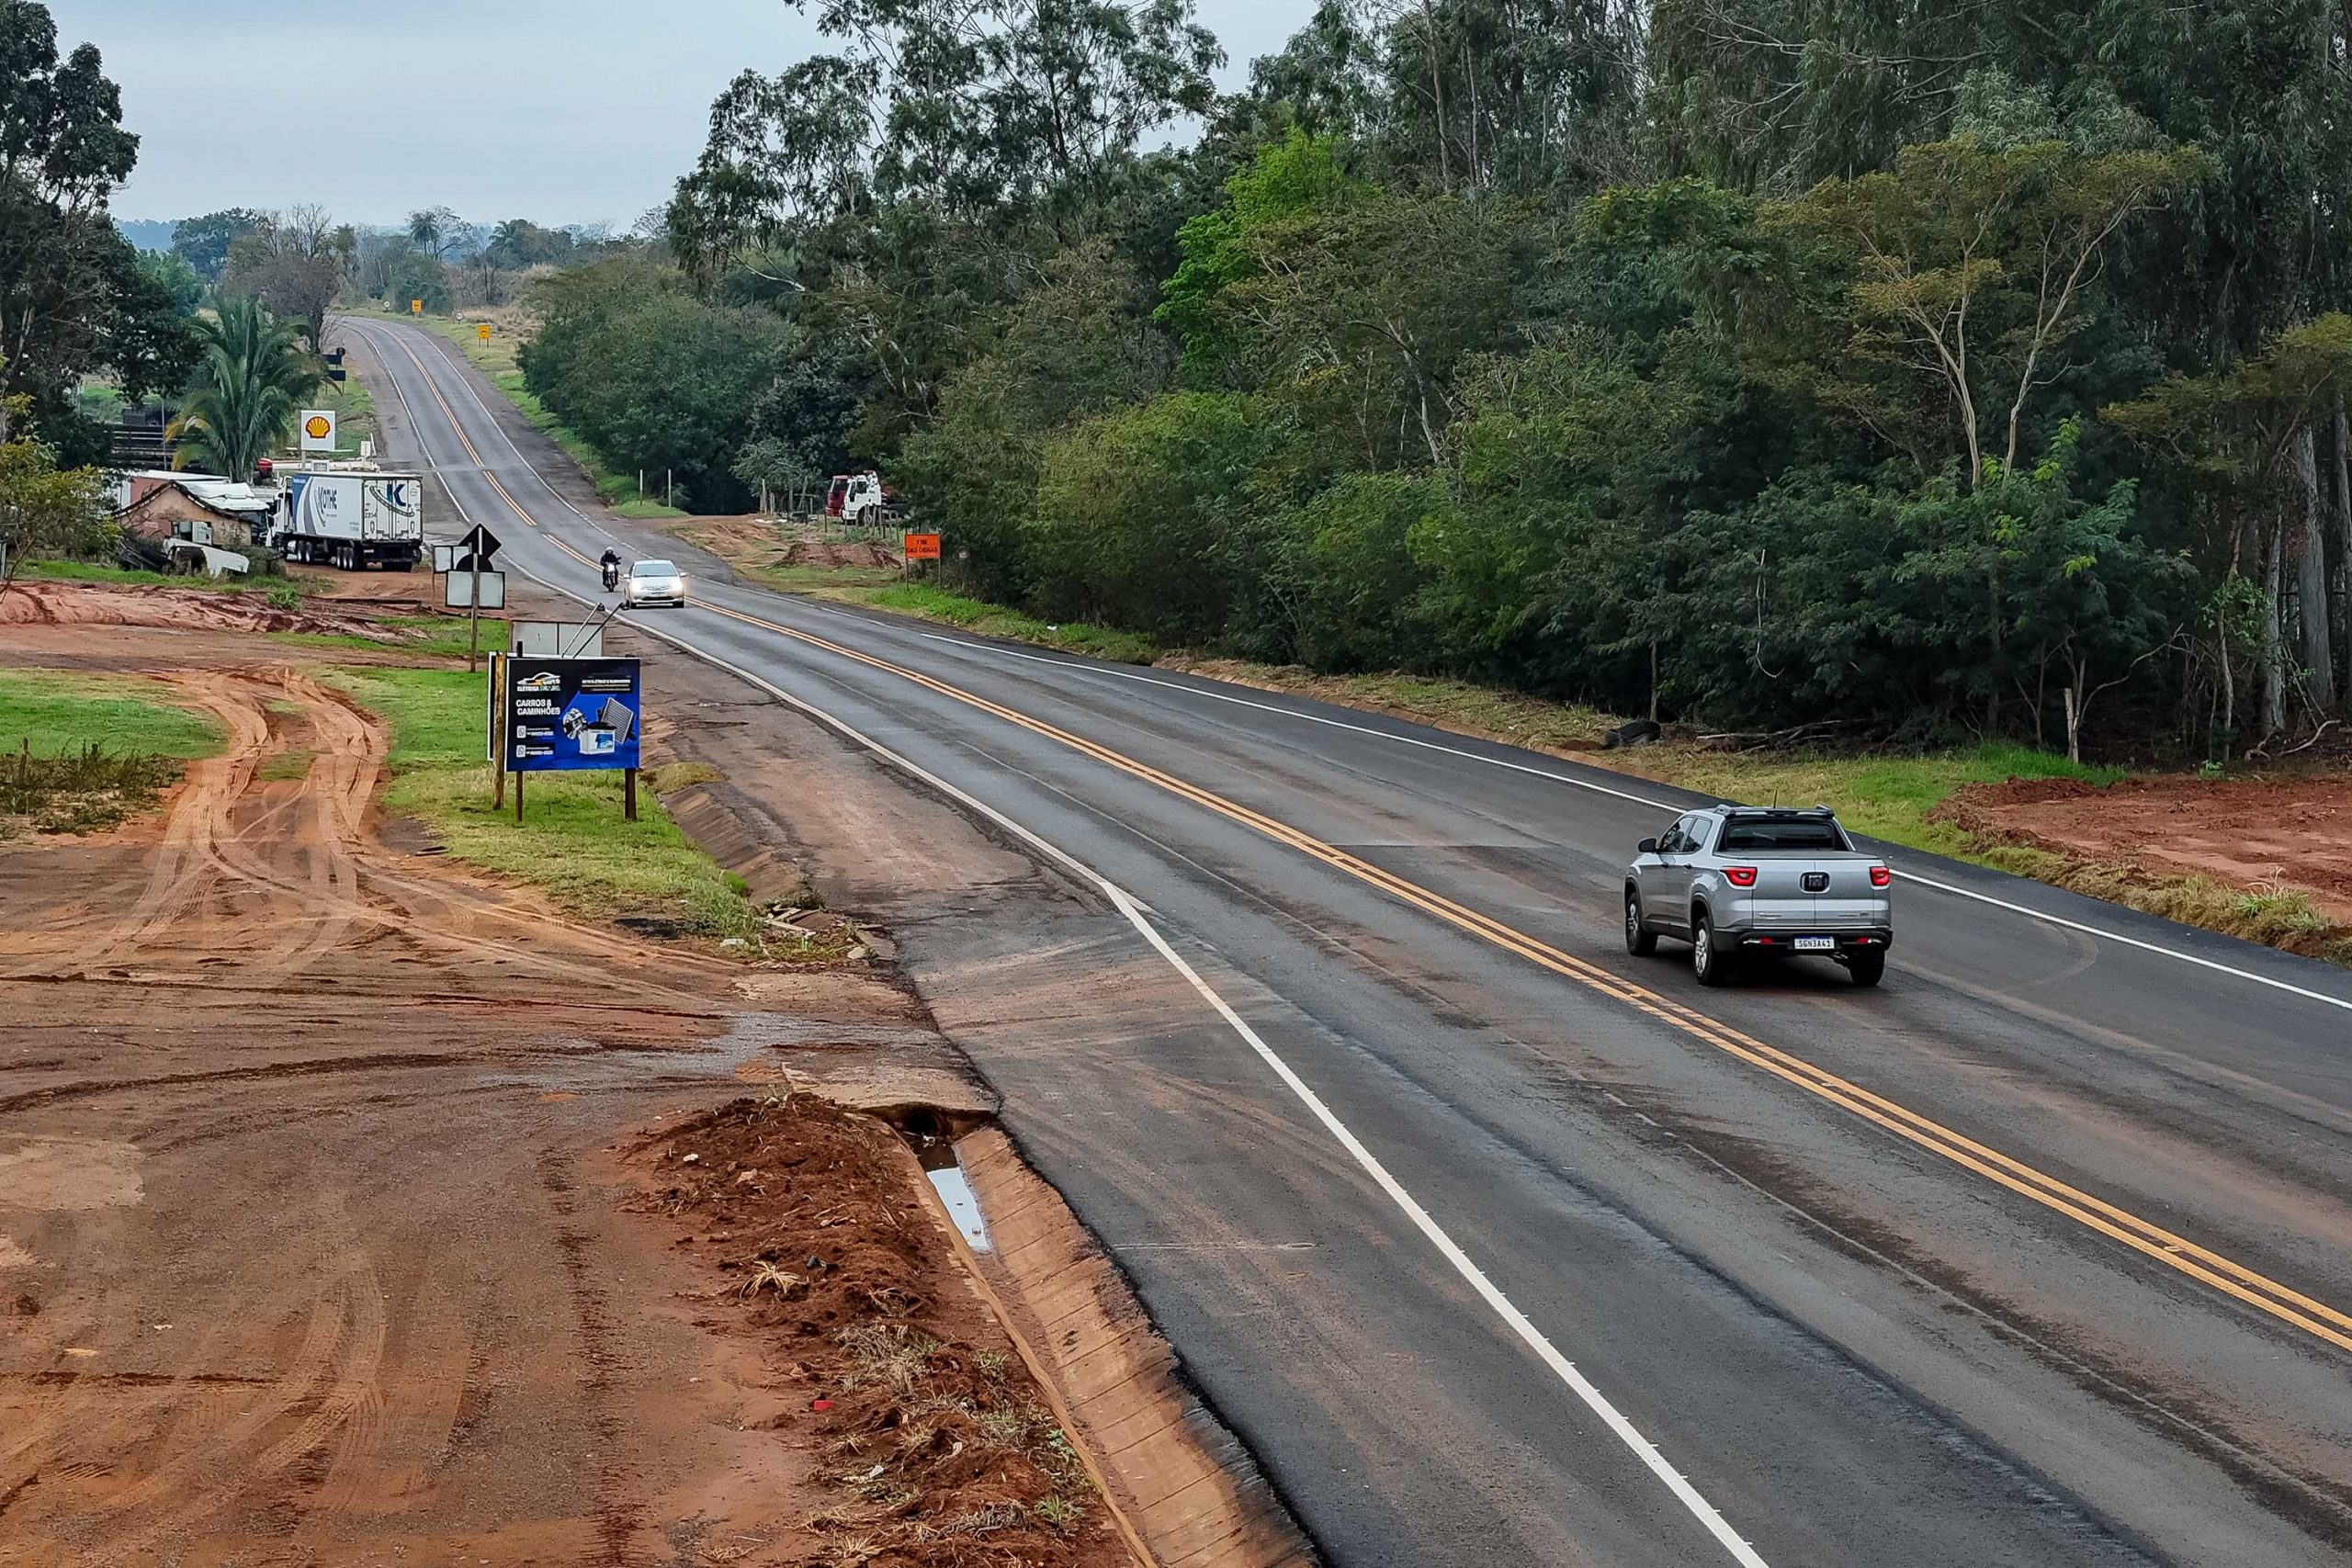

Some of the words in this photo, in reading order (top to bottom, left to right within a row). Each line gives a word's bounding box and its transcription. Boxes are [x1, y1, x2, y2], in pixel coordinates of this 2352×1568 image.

[515, 699, 547, 707] CARROS
[516, 706, 560, 716] CAMINHÕES
[1797, 939, 1831, 948] SGN3A41
